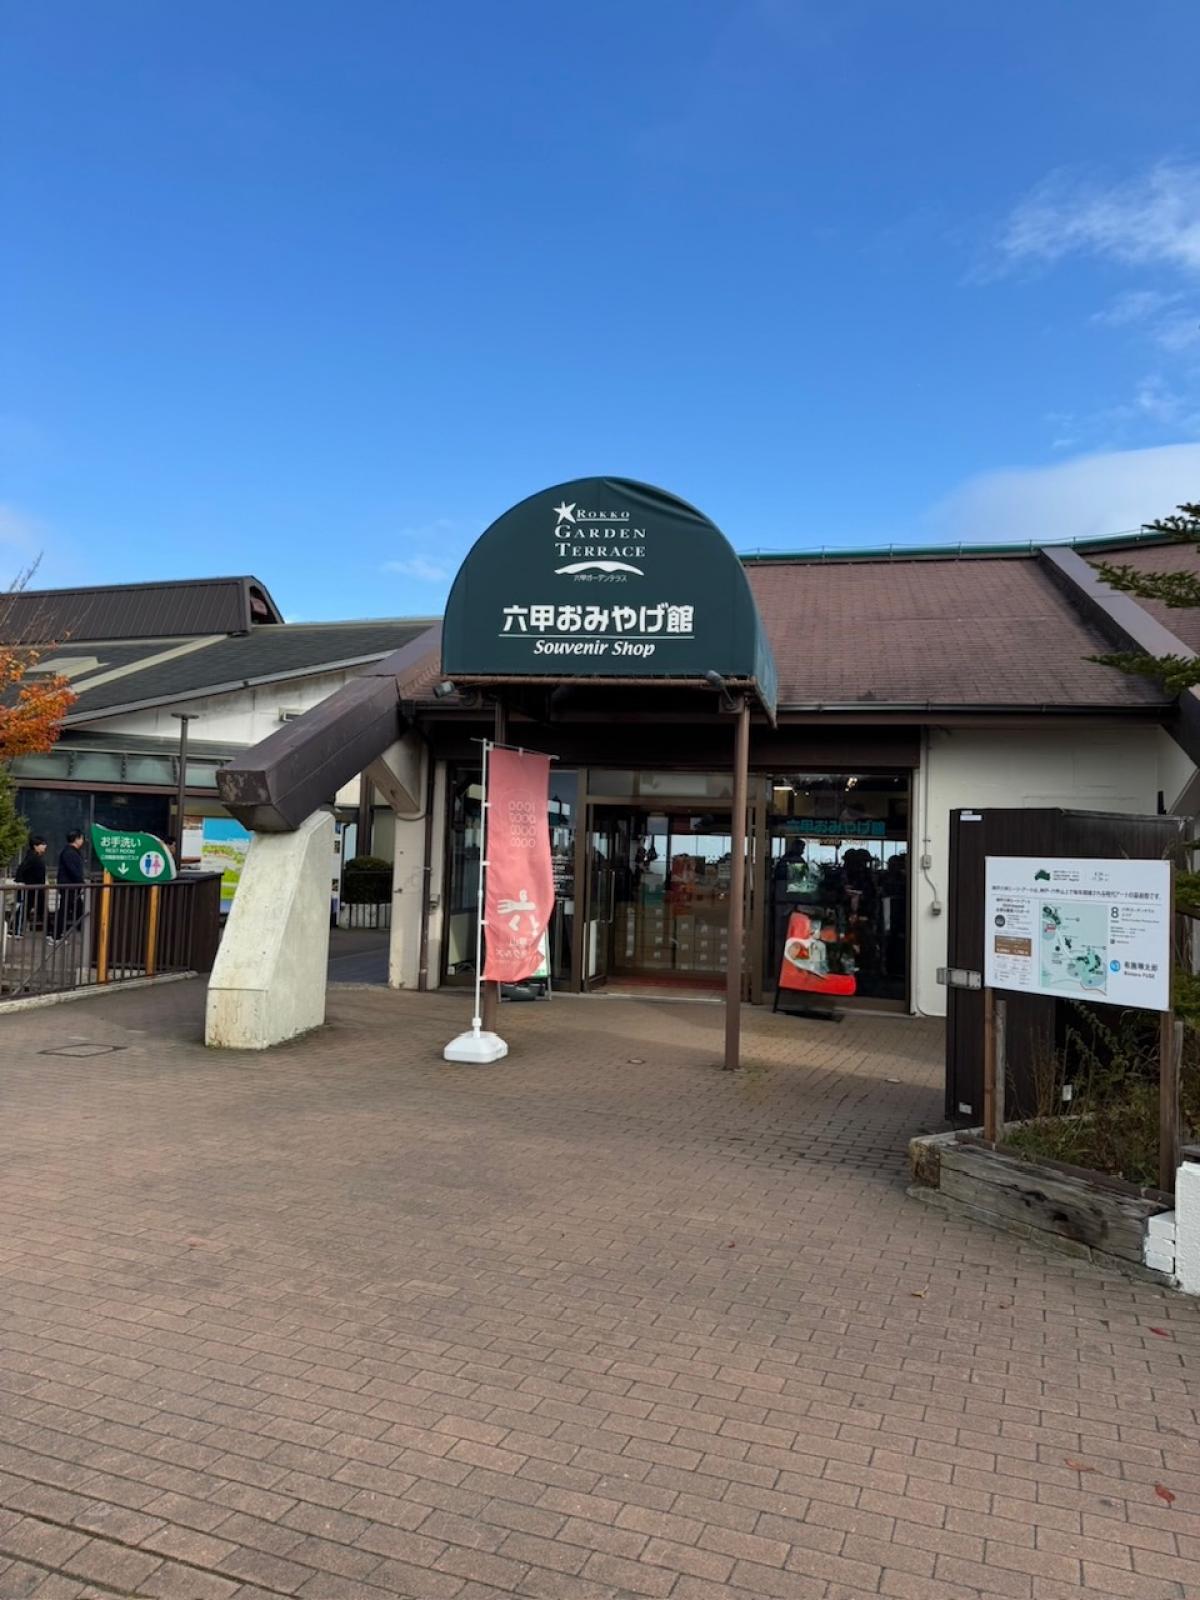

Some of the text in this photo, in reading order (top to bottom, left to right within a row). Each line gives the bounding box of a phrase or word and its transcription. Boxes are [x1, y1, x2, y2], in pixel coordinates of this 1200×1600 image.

[503, 603, 694, 633] 六甲おみやげ館
[533, 639, 656, 659] Souvenir Shop
[100, 836, 141, 848] お手洗い
[1110, 906, 1120, 919] 8
